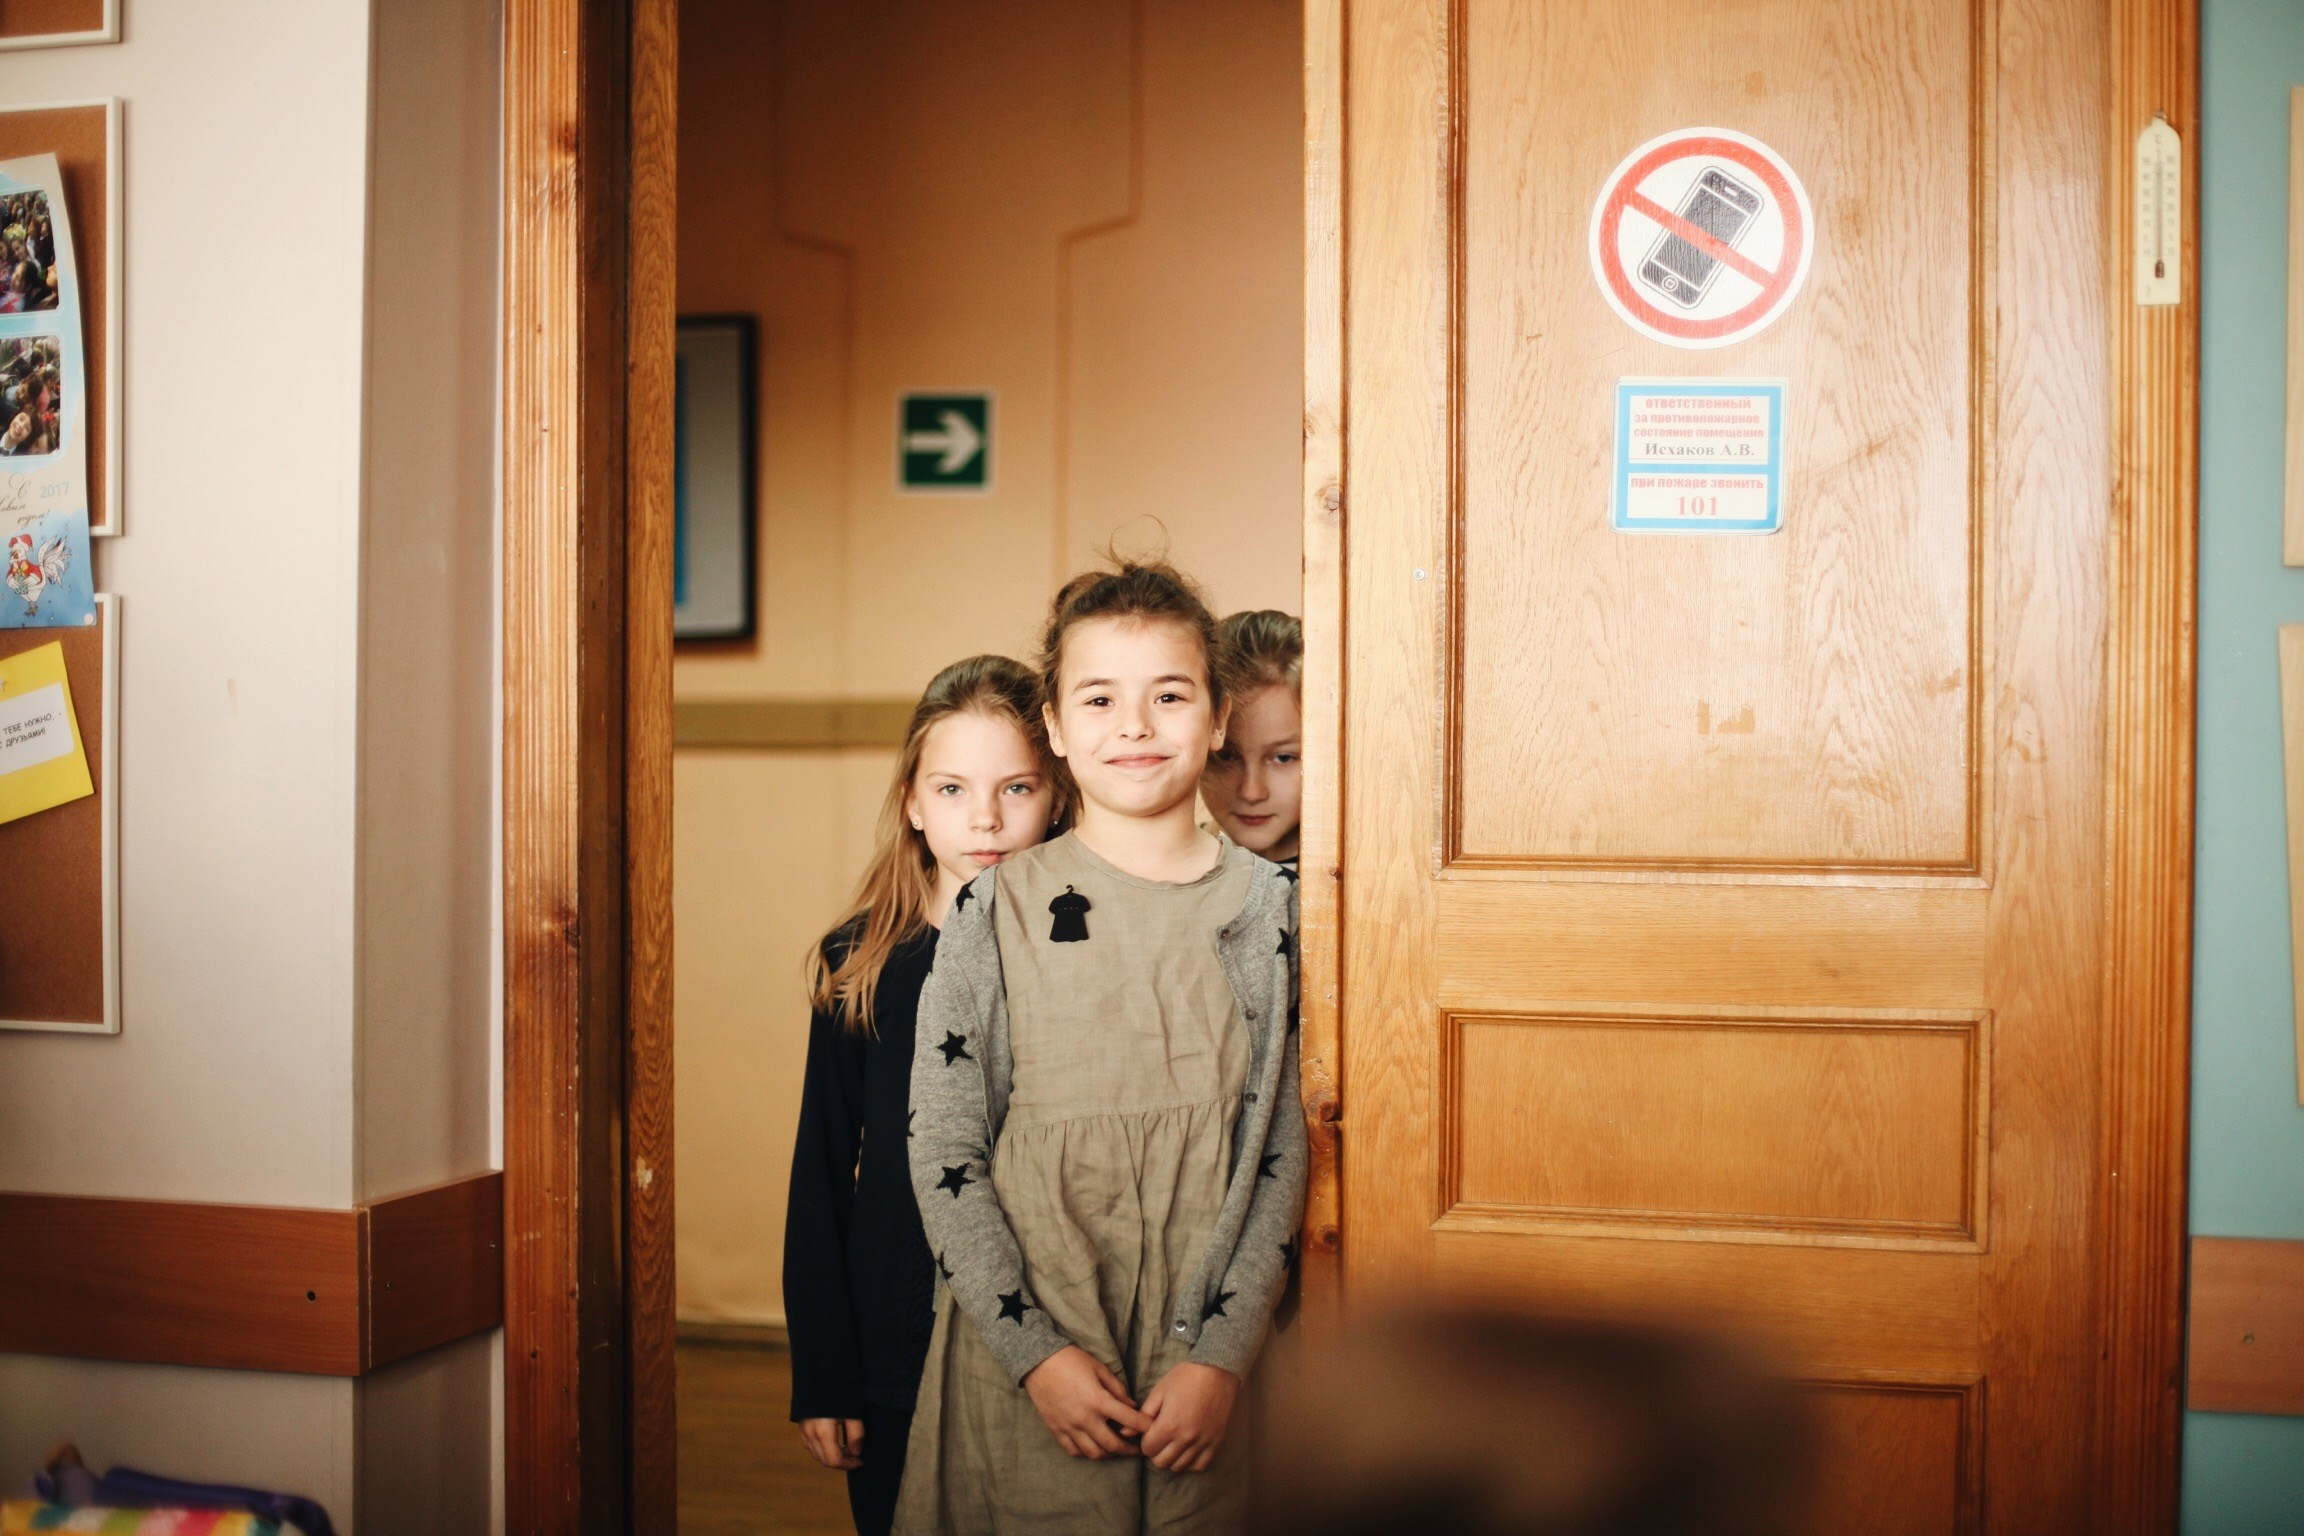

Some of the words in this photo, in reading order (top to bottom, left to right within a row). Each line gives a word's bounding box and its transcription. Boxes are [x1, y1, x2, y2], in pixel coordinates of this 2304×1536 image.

[1645, 397, 1751, 409] ответственный
[1634, 414, 1648, 423] за
[1650, 414, 1760, 425] противопожарное
[1633, 428, 1694, 438] состояние
[1695, 429, 1764, 439] помещения
[1645, 442, 1715, 456] Исхаков
[1720, 443, 1755, 457] А.В.
[1631, 477, 1655, 488] при
[1657, 478, 1707, 489] пожаре
[1710, 479, 1764, 489] звонить
[40, 482, 69, 498] 2017
[1677, 496, 1719, 516] 101
[3, 722, 22, 735] ТЕБЕ
